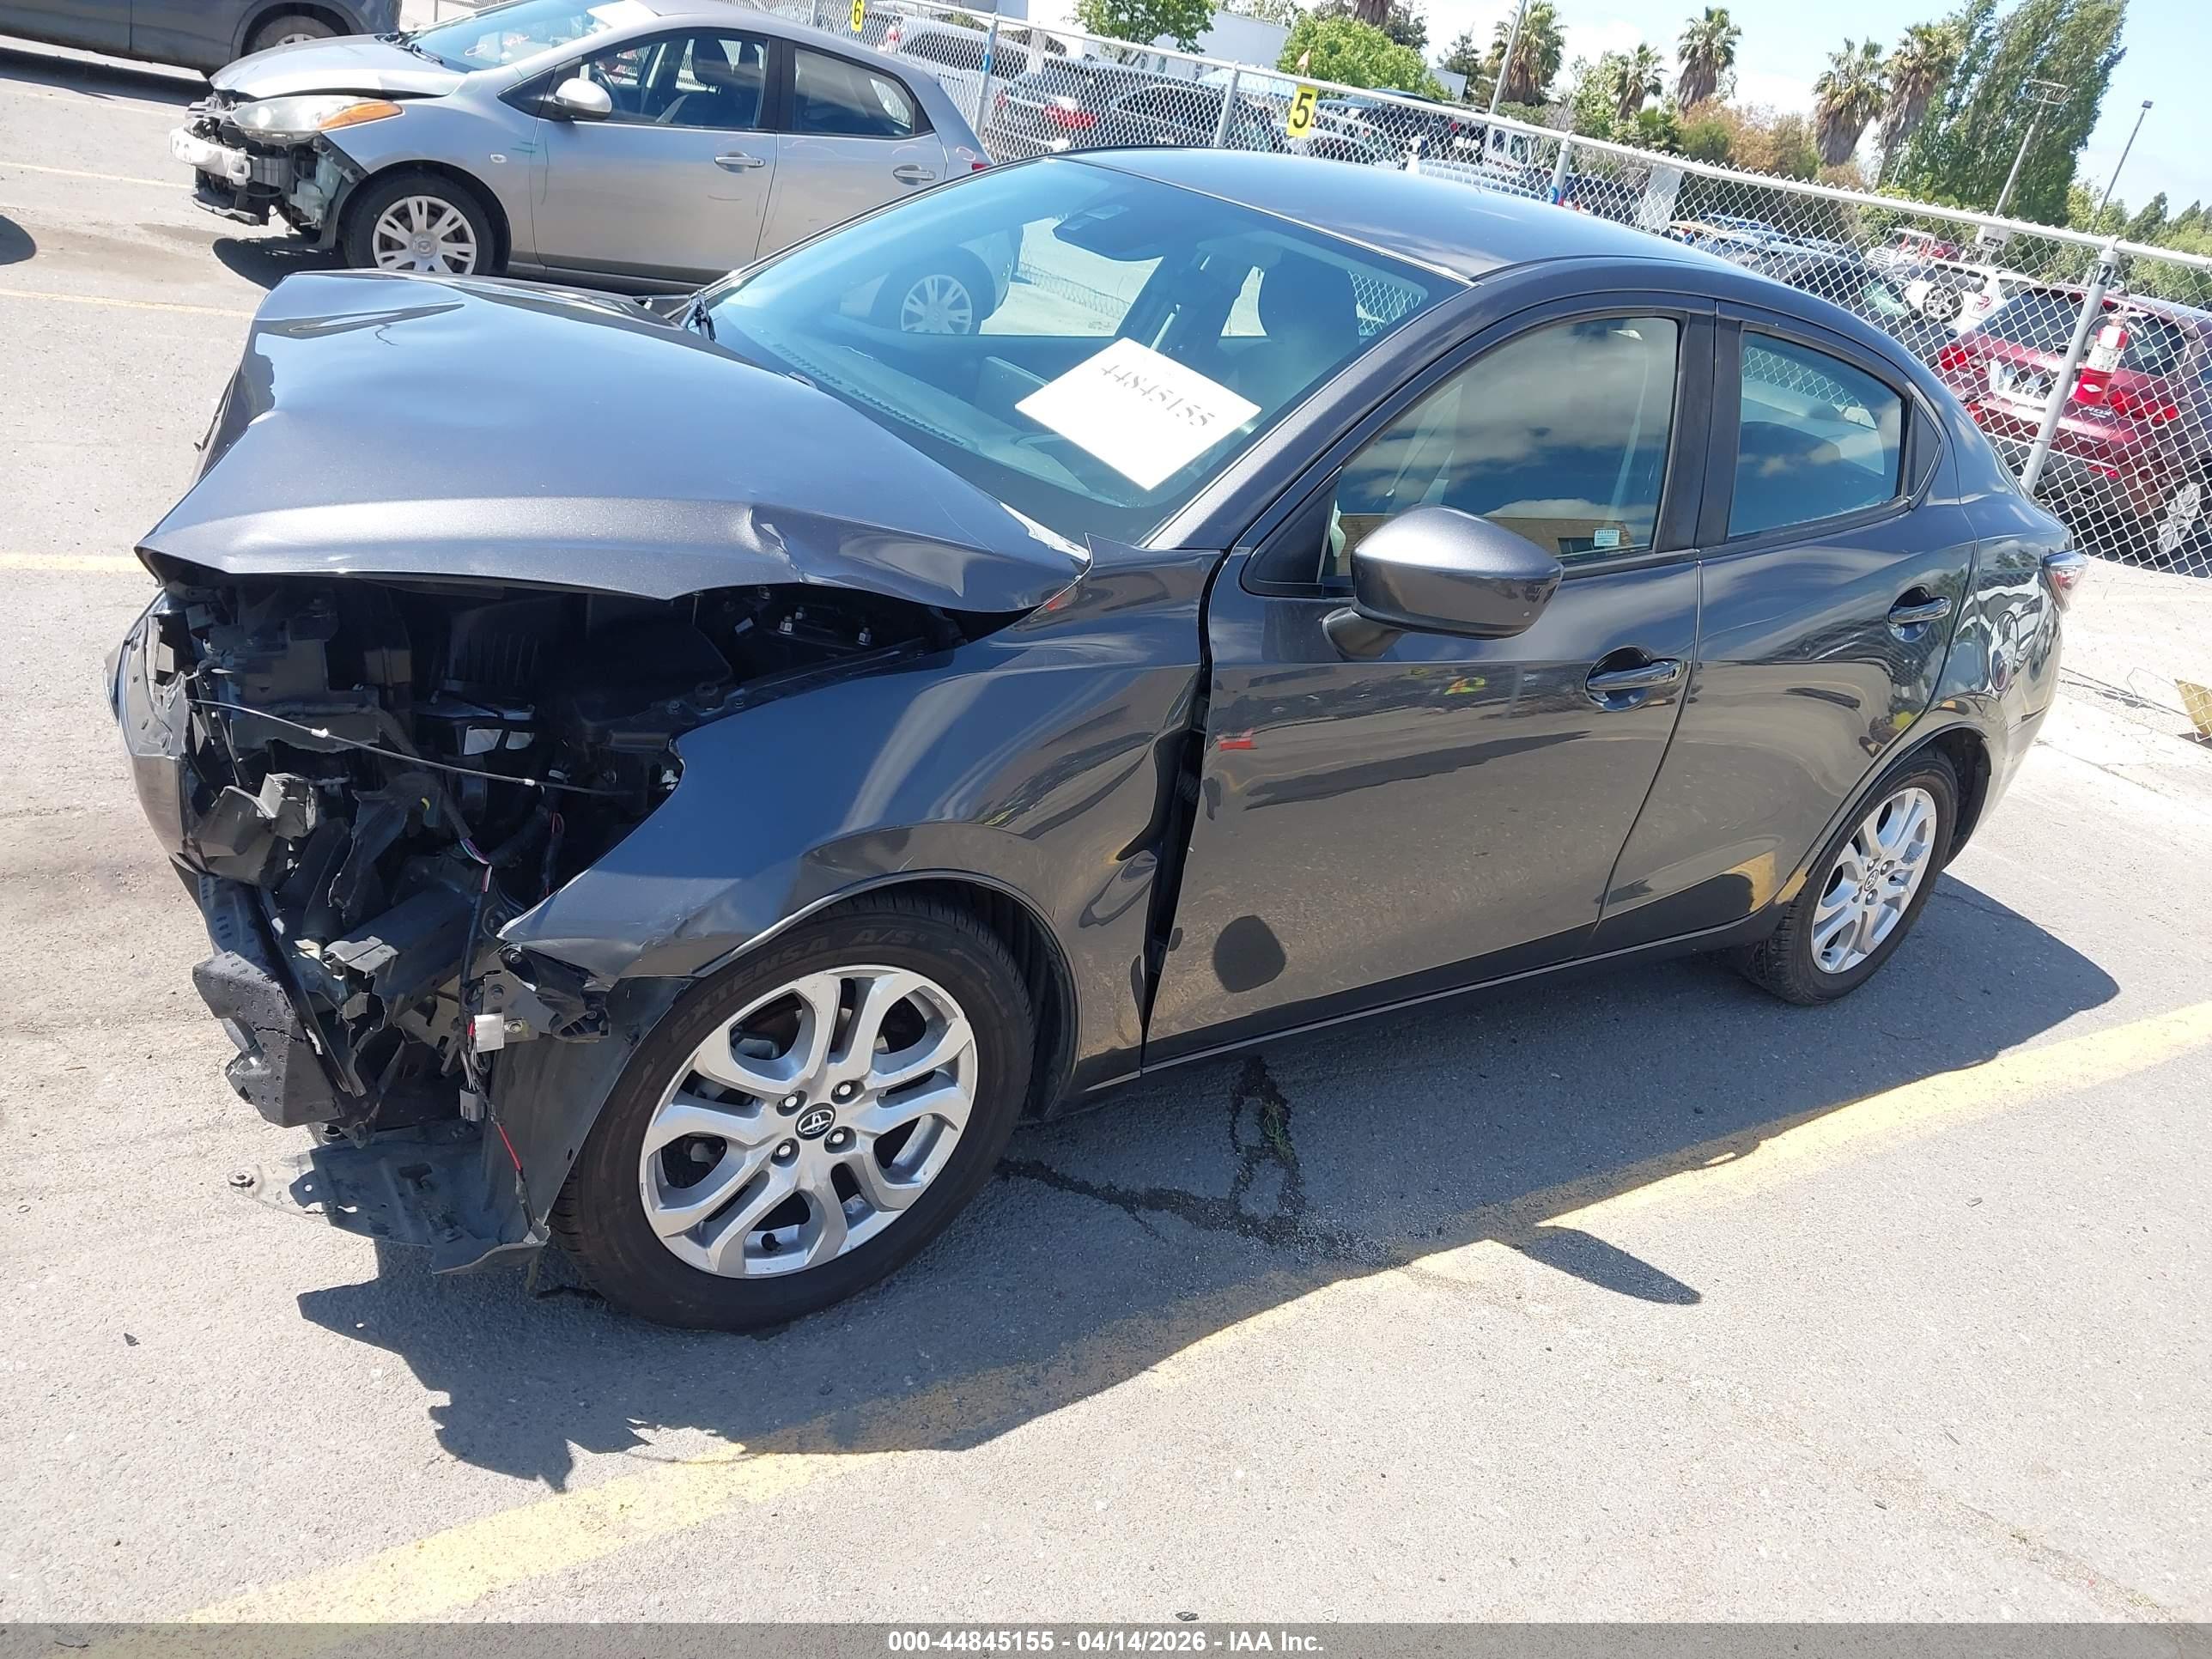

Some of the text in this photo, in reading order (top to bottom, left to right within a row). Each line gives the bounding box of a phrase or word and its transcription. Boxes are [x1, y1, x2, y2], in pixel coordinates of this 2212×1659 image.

[854, 0, 862, 25] 6
[1292, 92, 1313, 129] 5
[1101, 364, 1216, 427] 44845155
[672, 934, 832, 1037] EXTENSA
